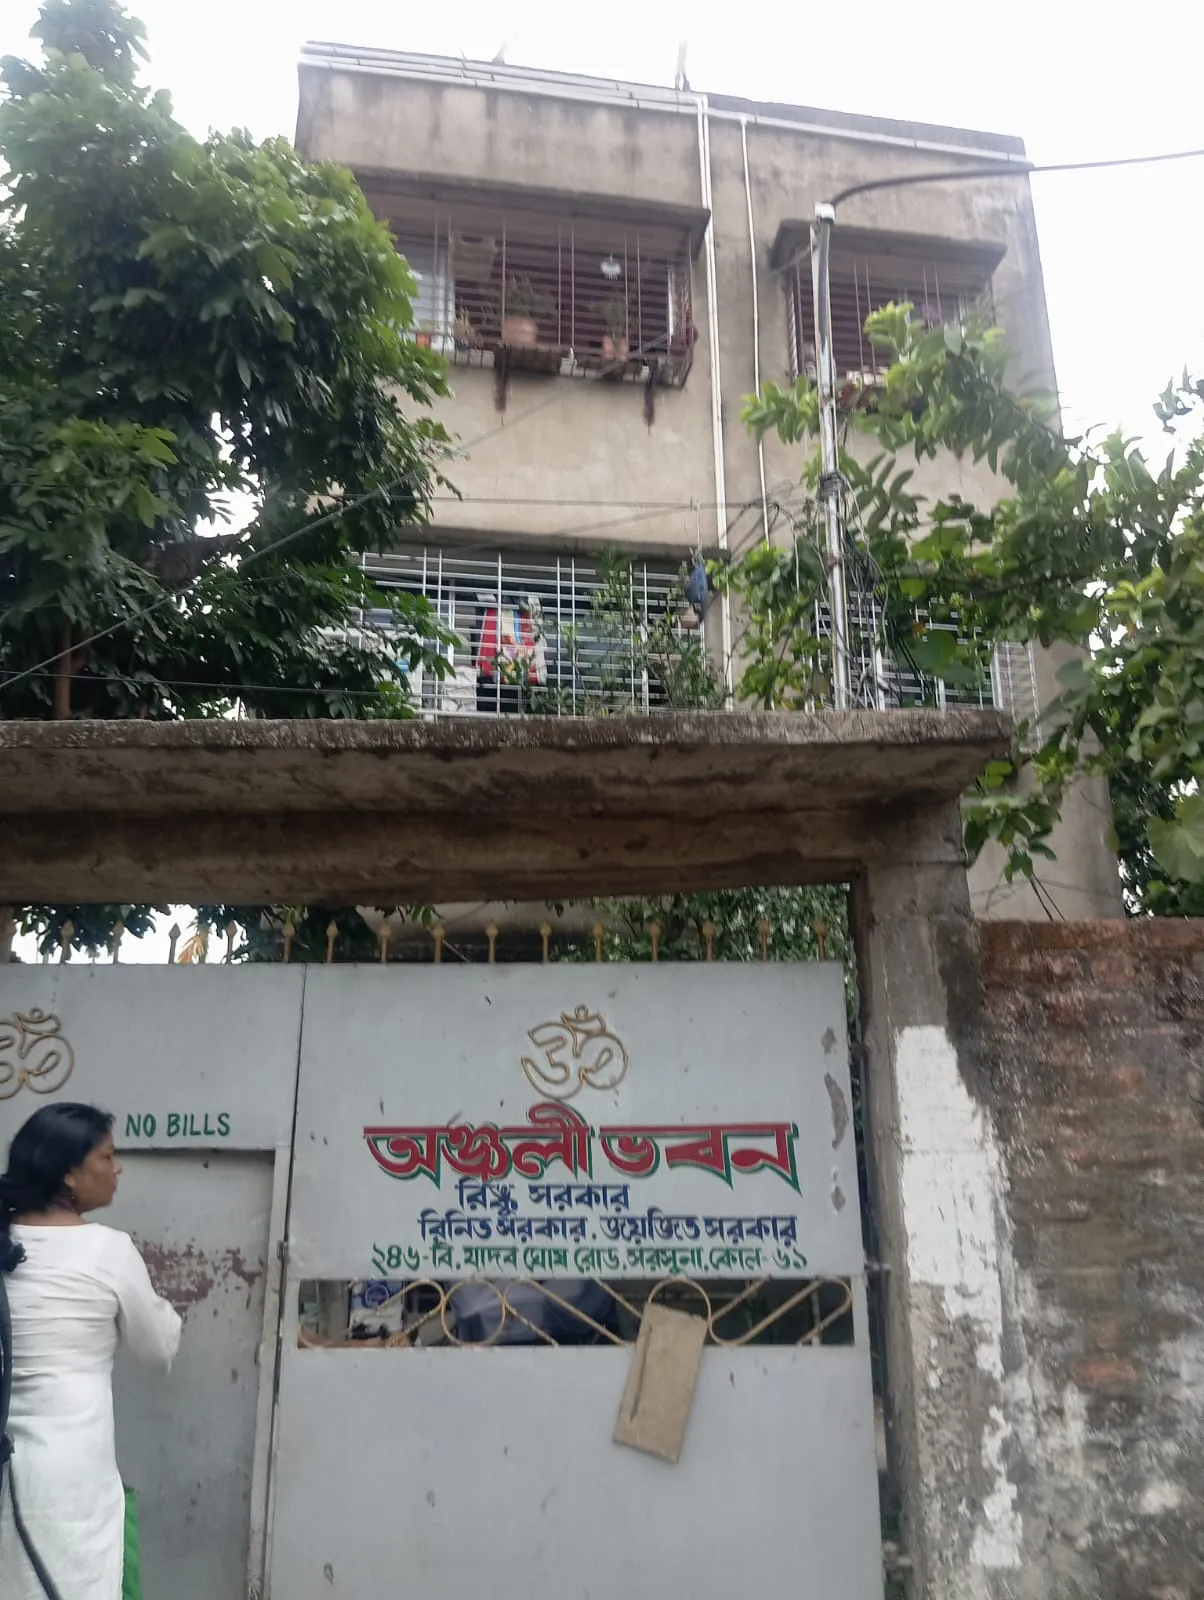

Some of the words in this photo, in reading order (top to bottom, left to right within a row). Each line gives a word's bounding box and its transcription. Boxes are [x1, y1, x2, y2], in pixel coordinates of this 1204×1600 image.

[125, 1113, 157, 1137] NO
[166, 1112, 231, 1137] BILLS
[362, 1102, 594, 1190] অঞ্জলী
[599, 1121, 803, 1197] ভবন
[528, 1184, 631, 1213] সরকার
[702, 1216, 798, 1247] সরকার
